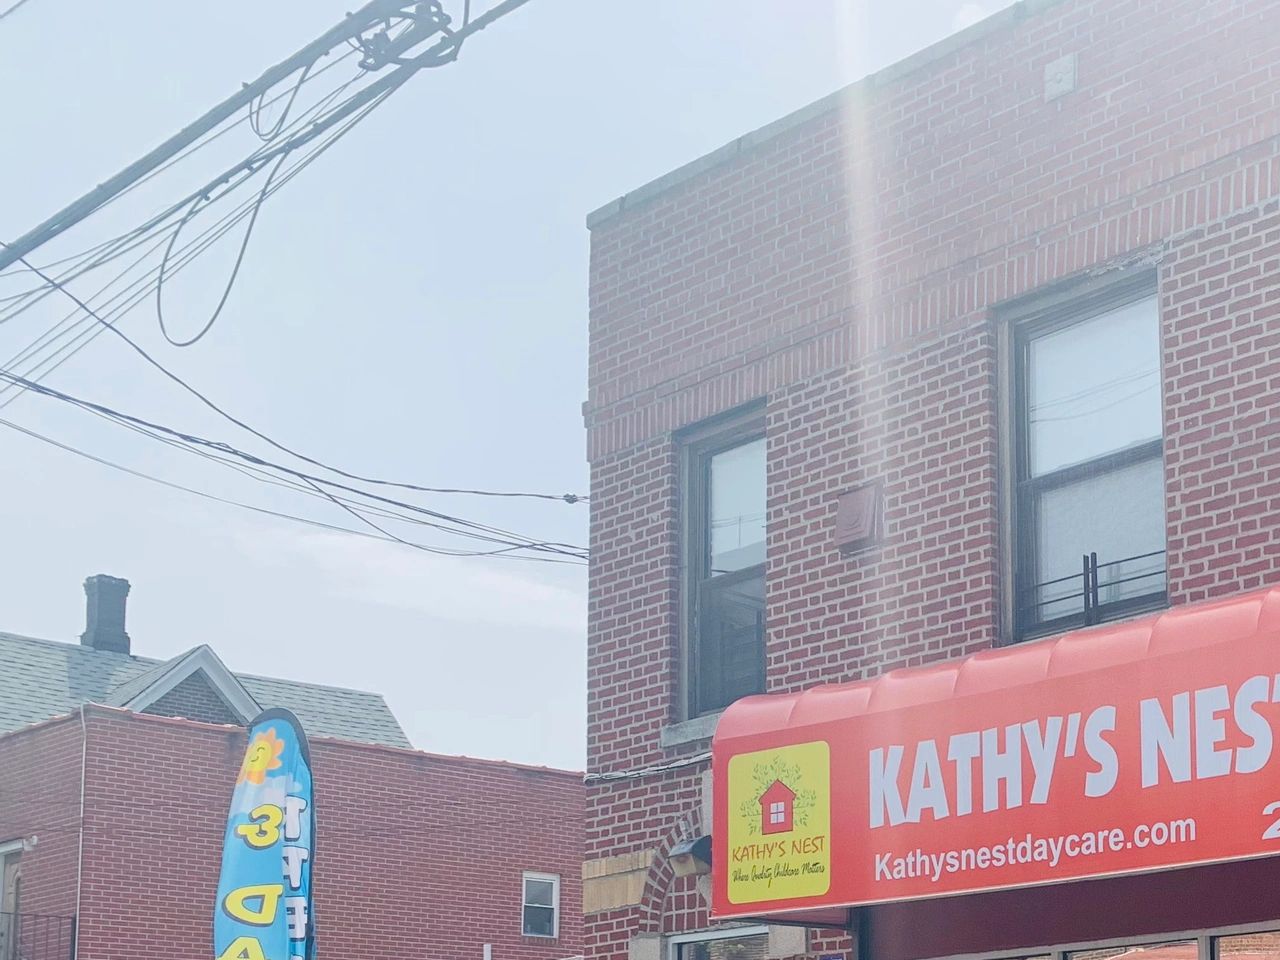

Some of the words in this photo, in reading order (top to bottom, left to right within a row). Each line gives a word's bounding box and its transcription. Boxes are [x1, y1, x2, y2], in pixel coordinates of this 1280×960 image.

[869, 704, 1120, 829] KATHY'S
[732, 841, 786, 862] KATHY'S
[791, 835, 825, 856] NEST
[874, 817, 1196, 882] Kathysnestdaycare.com
[732, 868, 749, 883] Where
